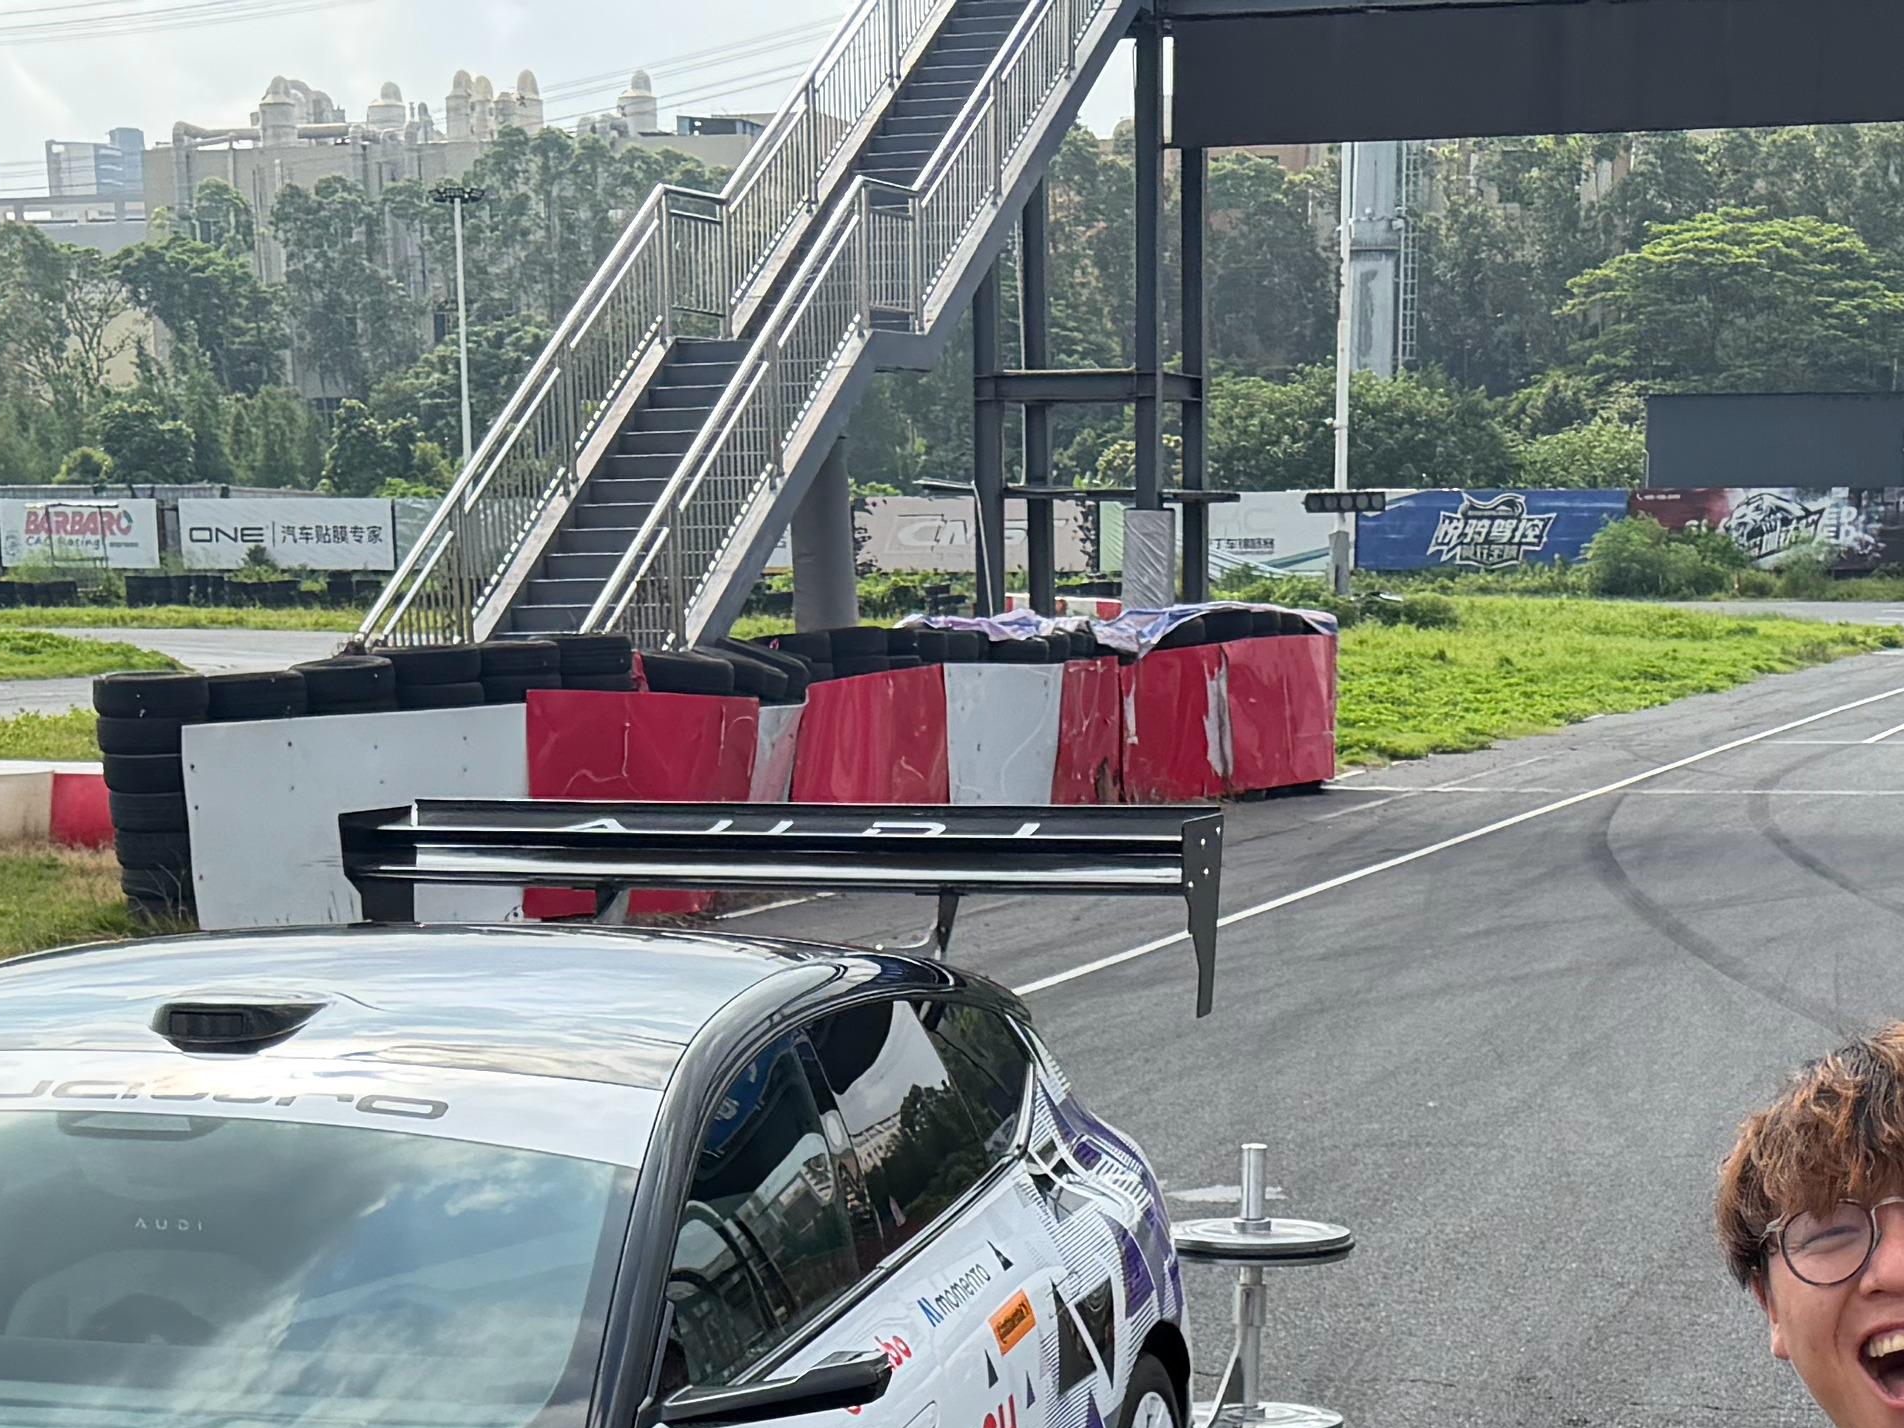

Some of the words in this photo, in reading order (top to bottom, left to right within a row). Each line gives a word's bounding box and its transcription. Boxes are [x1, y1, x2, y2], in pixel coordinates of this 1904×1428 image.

[189, 527, 264, 543] ONE
[281, 525, 383, 544] 汽车贴膜专家
[135, 1217, 202, 1231] AUDI
